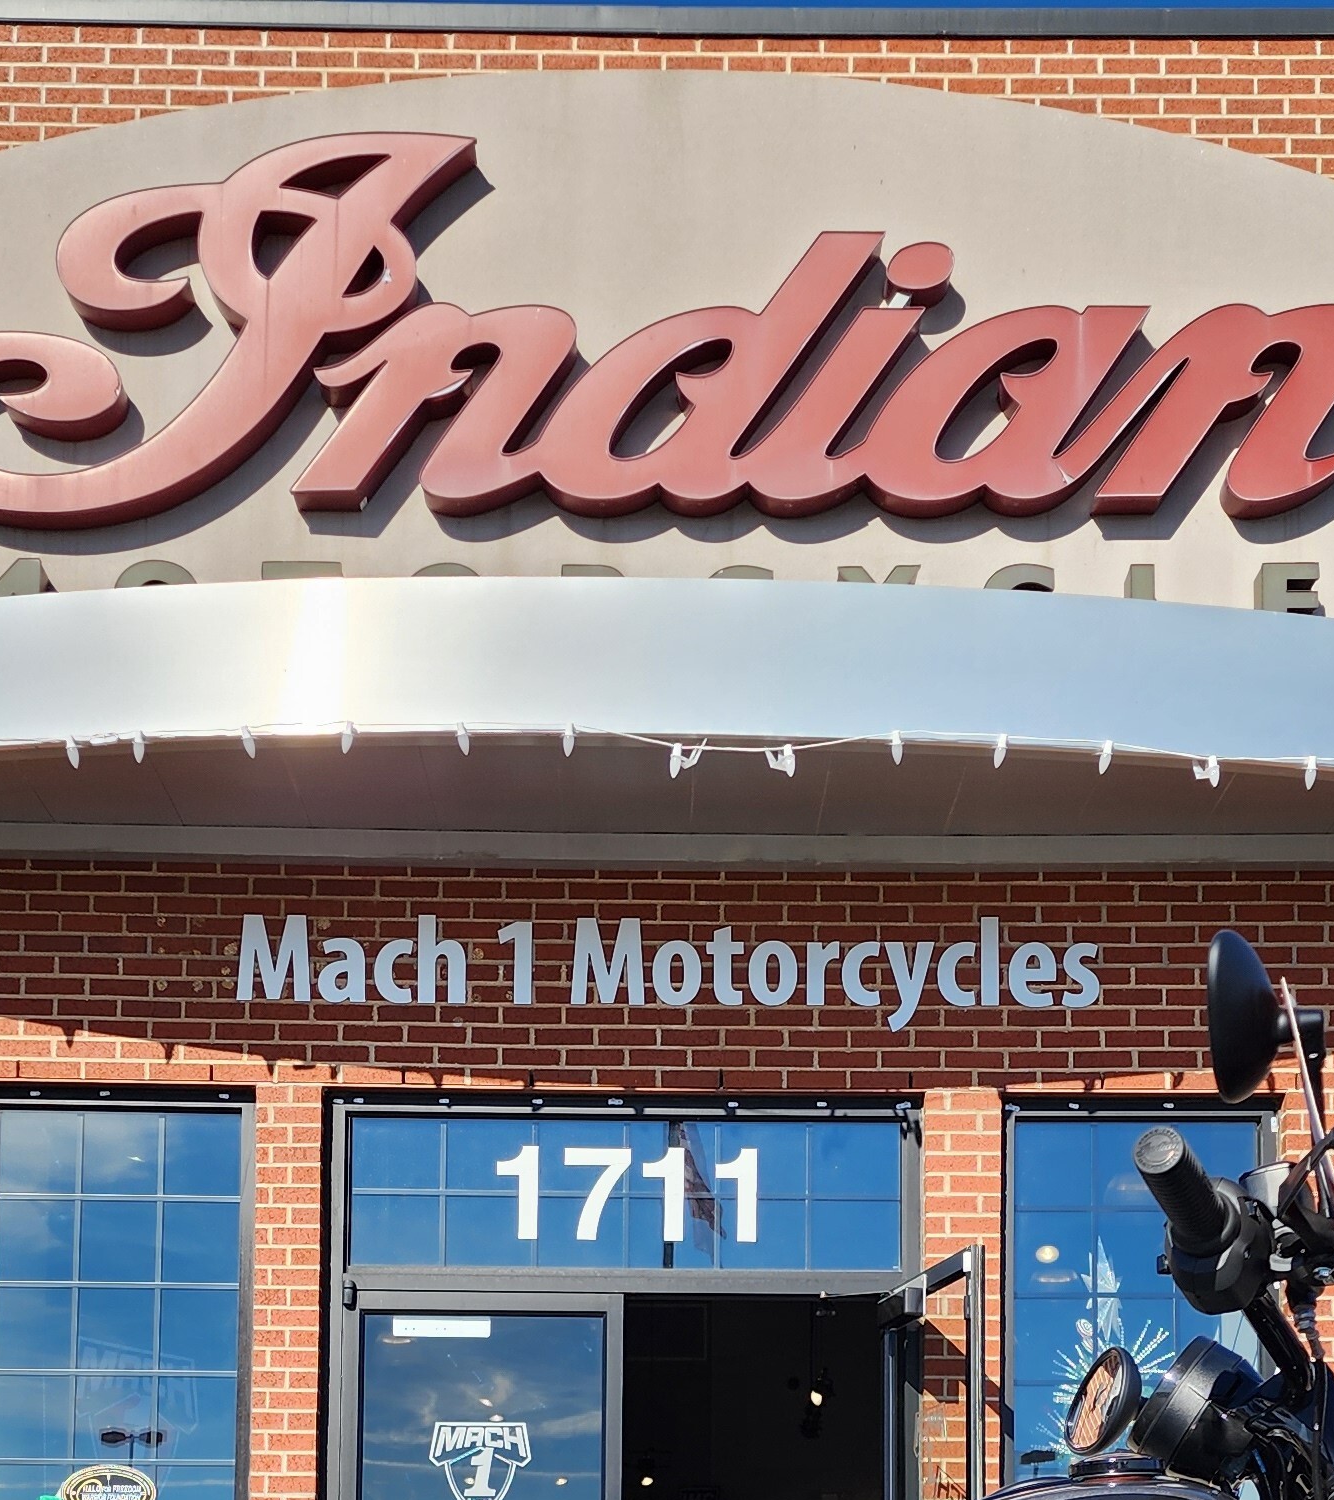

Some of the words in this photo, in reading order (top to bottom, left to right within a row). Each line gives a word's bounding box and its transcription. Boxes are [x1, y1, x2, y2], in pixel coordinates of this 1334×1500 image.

[236, 914, 468, 1004] Mach
[497, 921, 534, 1005] 1
[569, 916, 1101, 1033] Motorcycles
[496, 1145, 758, 1243] 1711
[434, 1426, 527, 1458] MACH
[464, 1447, 496, 1497] 1
